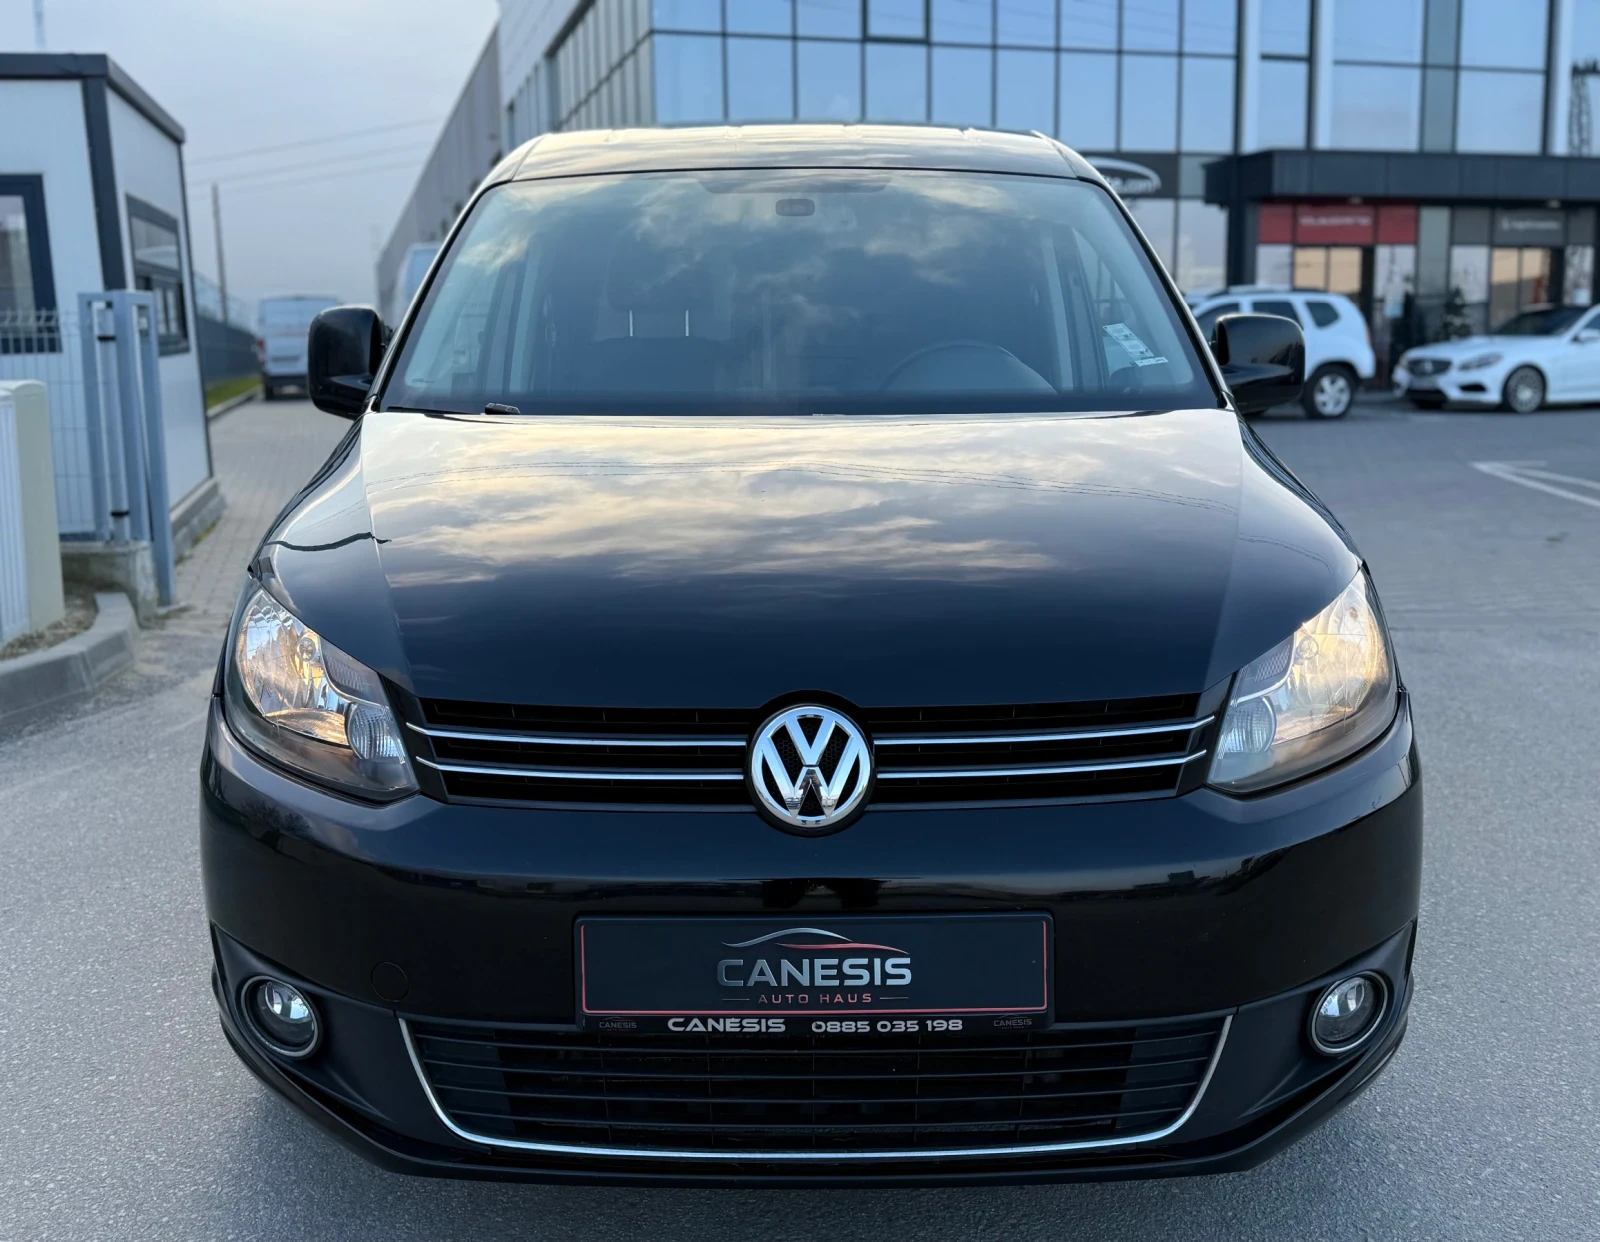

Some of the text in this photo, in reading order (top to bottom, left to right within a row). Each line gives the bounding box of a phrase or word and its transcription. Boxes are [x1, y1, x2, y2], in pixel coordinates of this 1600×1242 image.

[752, 706, 870, 827] VW
[717, 957, 913, 987] CANESIS
[758, 993, 872, 1004] AUTO HAUS
[599, 1021, 638, 1029] CANESIS
[667, 1017, 963, 1033] CANESIS 0885 035 198
[993, 1019, 1033, 1028] CANESIS
